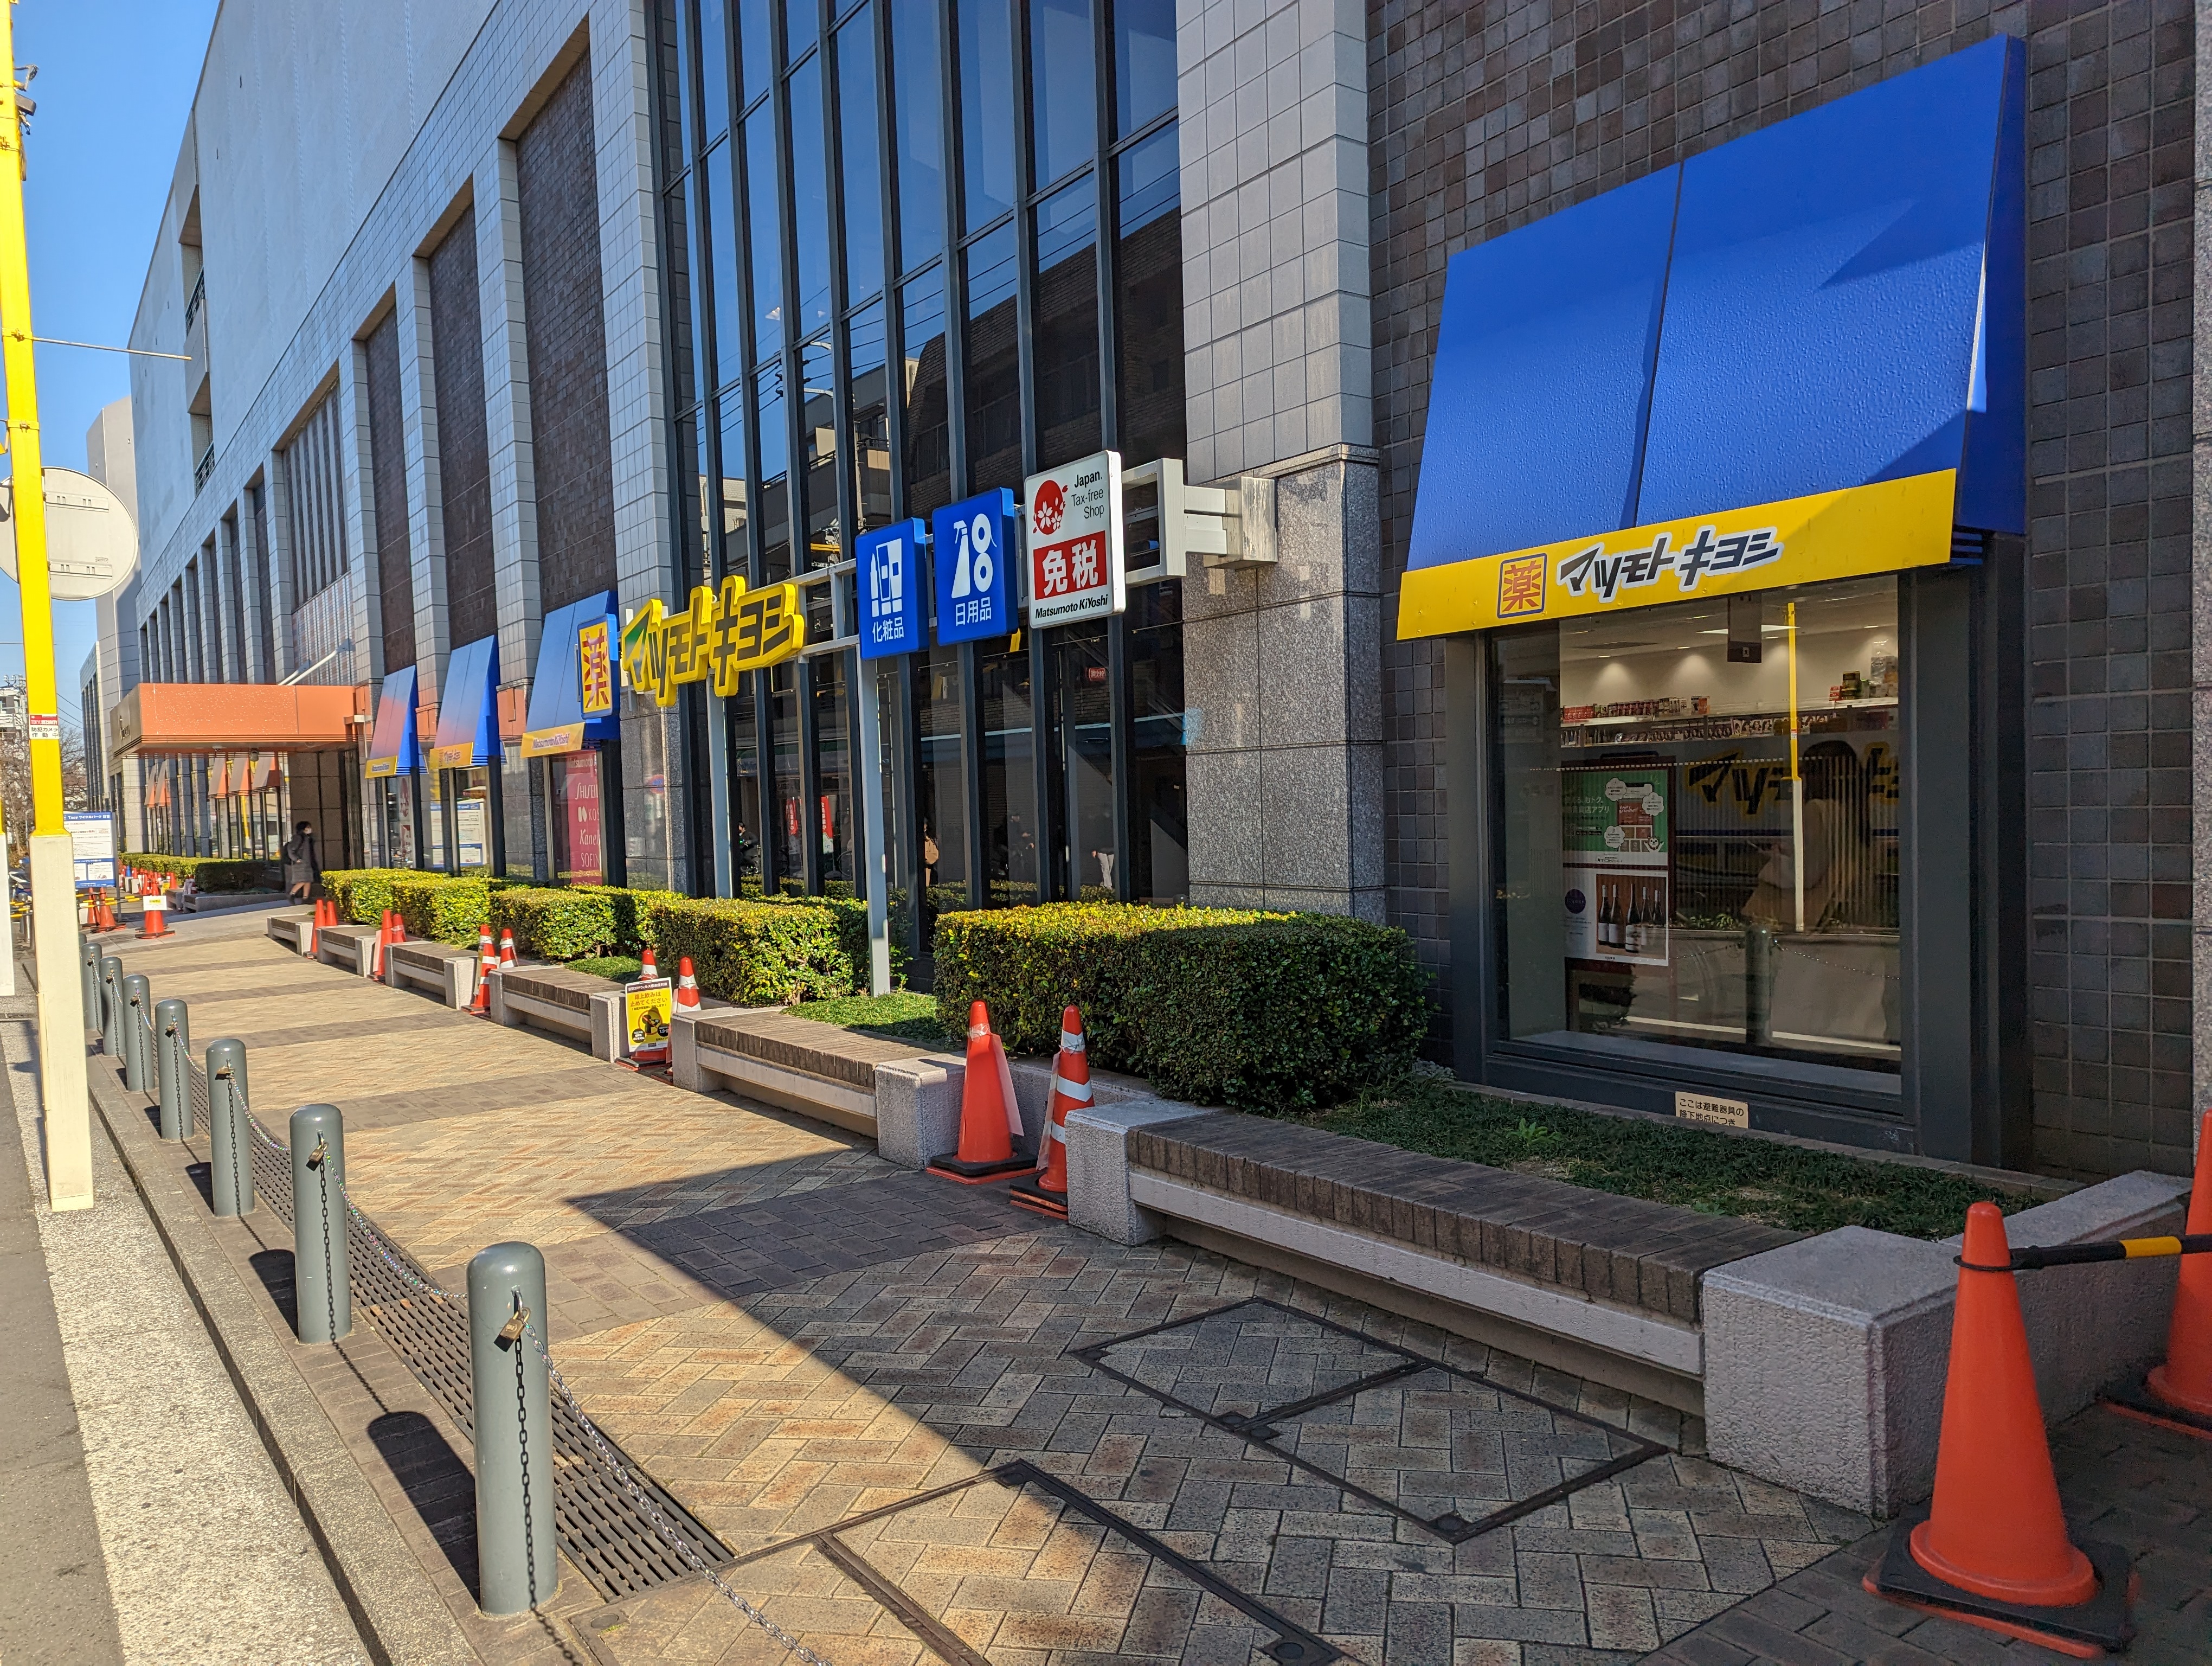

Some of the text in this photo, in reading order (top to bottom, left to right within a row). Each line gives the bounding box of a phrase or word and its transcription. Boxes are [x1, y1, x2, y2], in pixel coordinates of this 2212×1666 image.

[1071, 488, 1104, 507] Tax-free
[1084, 504, 1104, 519] Shop
[1042, 539, 1098, 597] 免税
[1560, 529, 1780, 599] マツモトキヨシ
[1502, 560, 1542, 612] 薬
[955, 596, 992, 627] 日用品
[1035, 593, 1108, 619] Matsumoto KiYoshi
[624, 586, 790, 699] マツモトキヨシ
[872, 616, 904, 644] 化粧品
[581, 627, 609, 708] 薬
[575, 782, 599, 800] SHISEI
[630, 998, 668, 1007] 止めてください
[1679, 1109, 1737, 1126] 降下地点につき
[1680, 1098, 1744, 1117] ここは避難器具の
